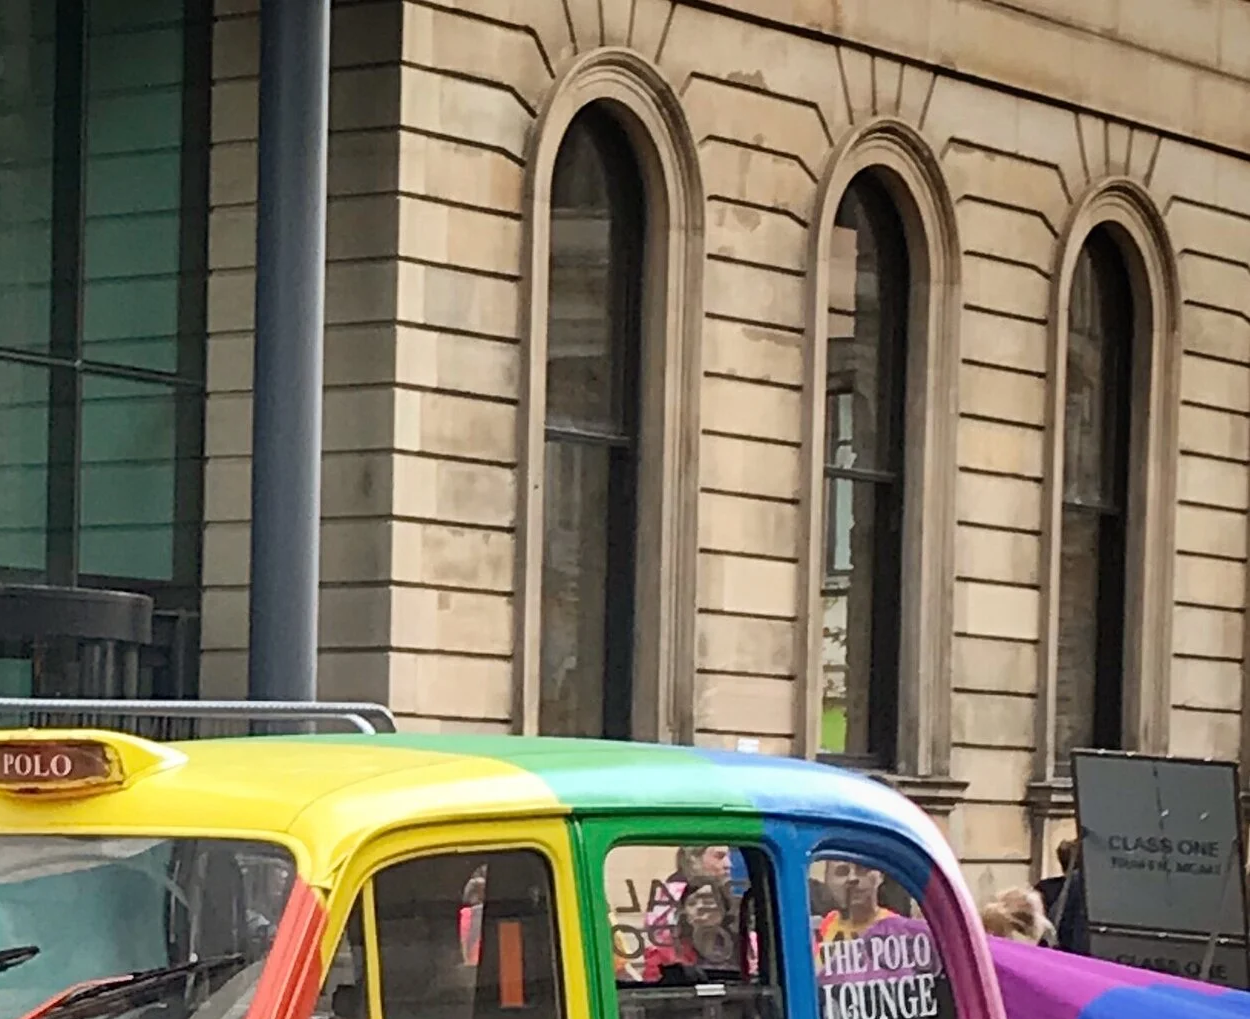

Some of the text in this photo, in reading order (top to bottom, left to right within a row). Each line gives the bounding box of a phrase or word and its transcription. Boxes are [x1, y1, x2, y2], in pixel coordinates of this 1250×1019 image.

[3, 753, 72, 777] POLO
[1108, 835, 1219, 857] CLASS ONE
[818, 932, 931, 976] THE POLO
